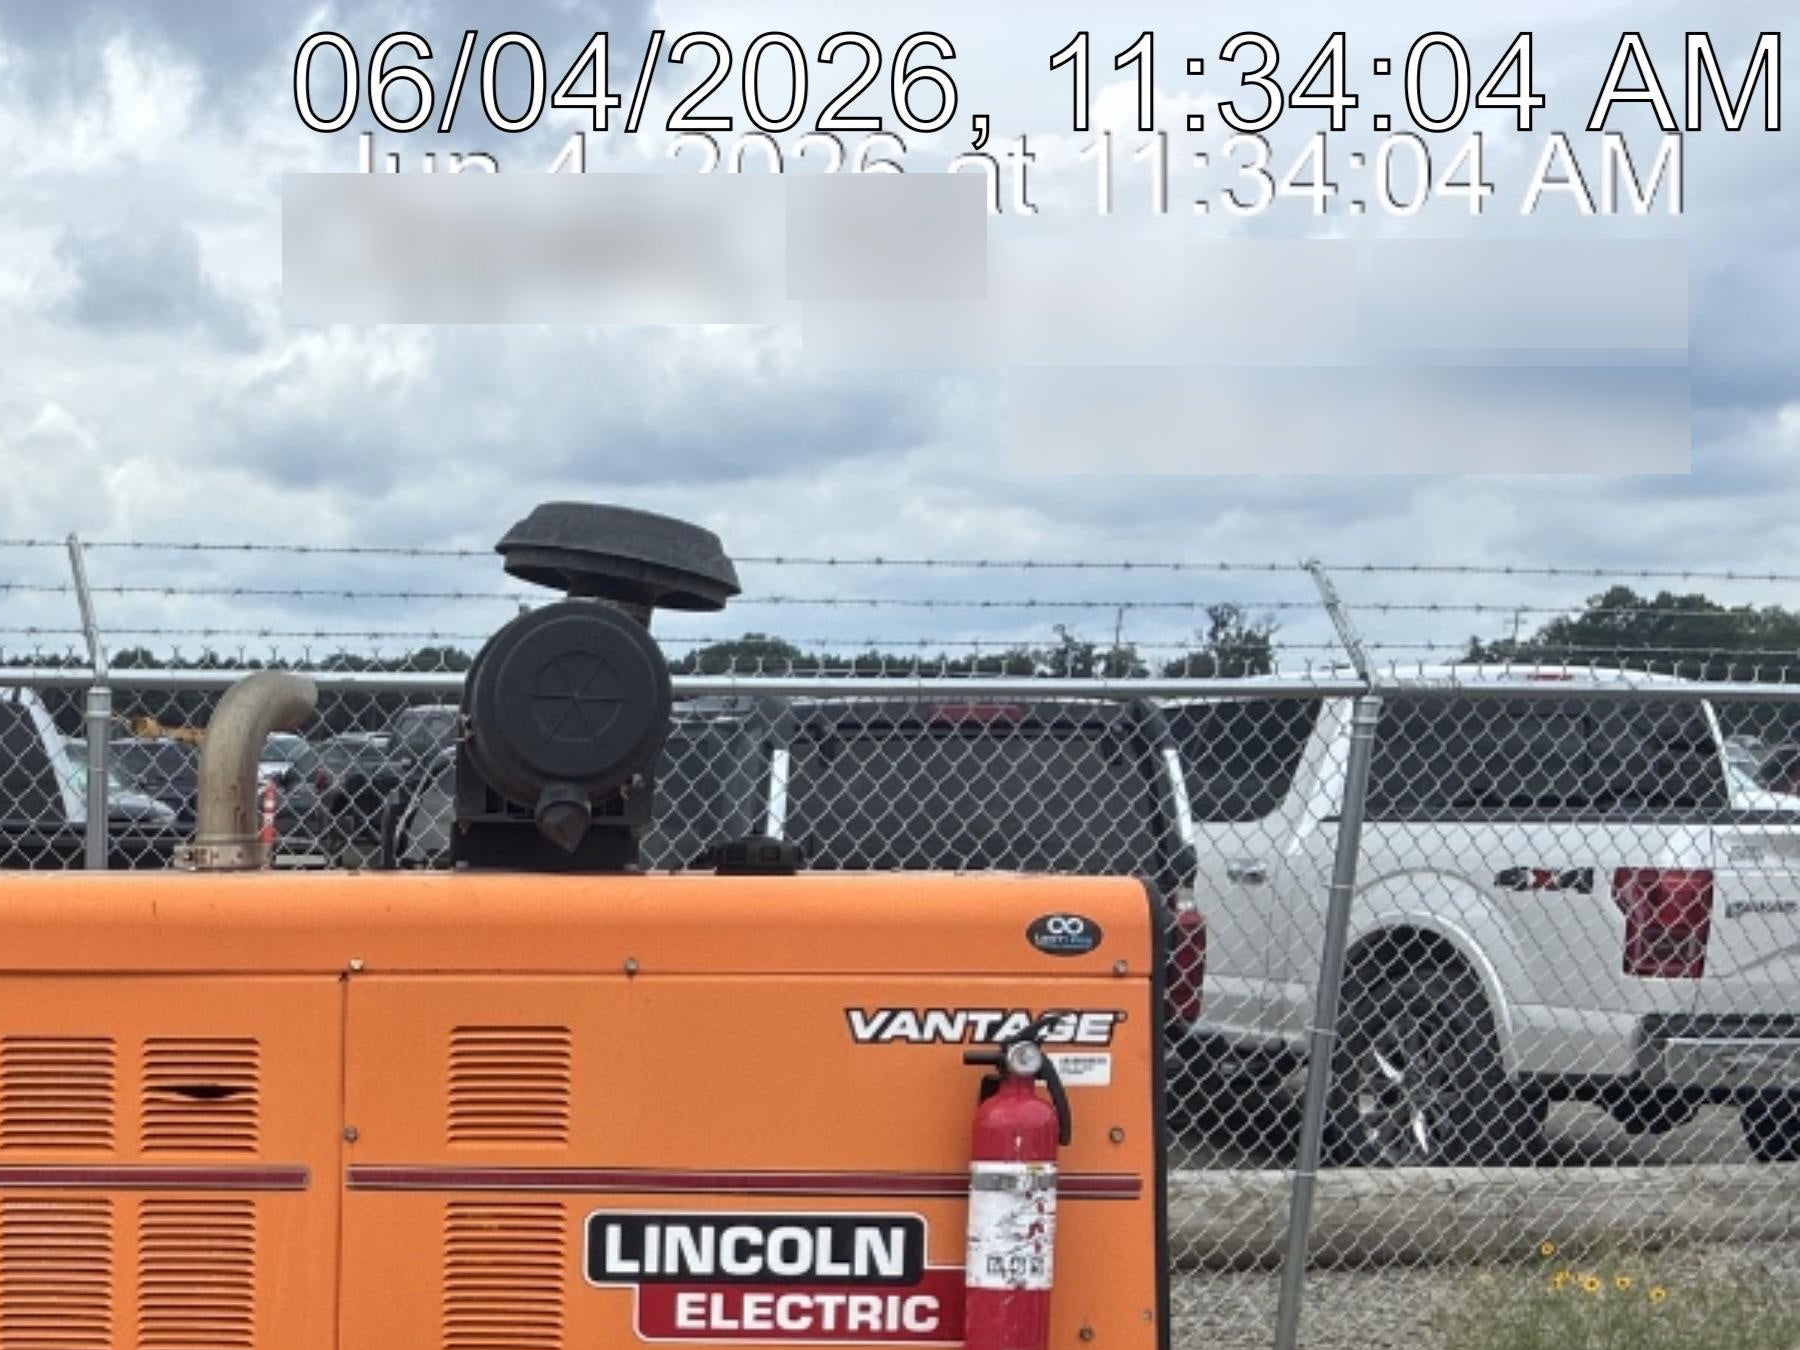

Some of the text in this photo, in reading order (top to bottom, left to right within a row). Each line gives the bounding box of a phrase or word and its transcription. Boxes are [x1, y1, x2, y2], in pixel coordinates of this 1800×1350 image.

[844, 1007, 1116, 1046] VANTAGE
[605, 1224, 906, 1277] LINCOLN
[675, 1292, 940, 1333] ELECTRIC
